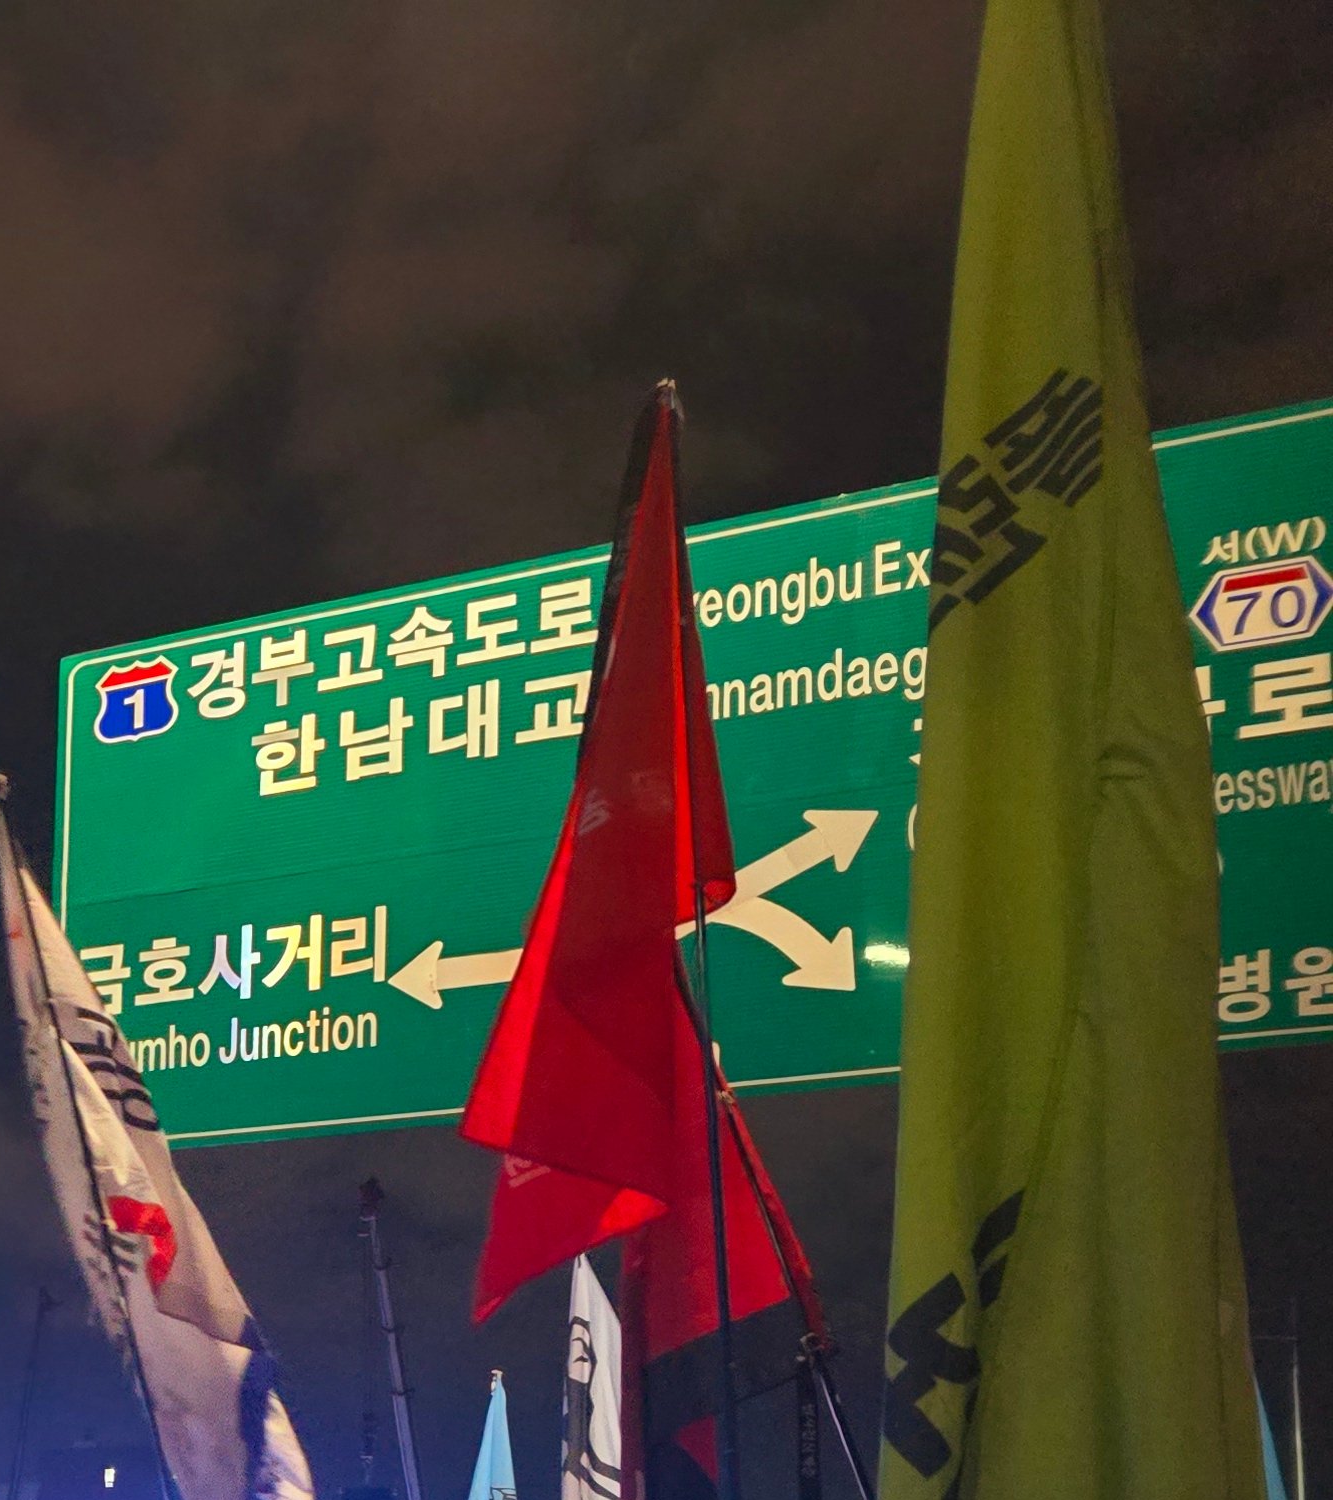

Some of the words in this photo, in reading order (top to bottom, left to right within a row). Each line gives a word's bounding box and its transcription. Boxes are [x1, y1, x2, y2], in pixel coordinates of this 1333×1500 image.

[693, 556, 863, 628] eongbu
[1226, 585, 1308, 636] 70
[186, 577, 600, 719] 경부고속도로
[705, 647, 929, 721] nnamdaeg
[123, 688, 146, 730] 1
[251, 669, 594, 798] 한남대교
[80, 904, 388, 1015] 금호사거리
[219, 1006, 379, 1065] Junction
